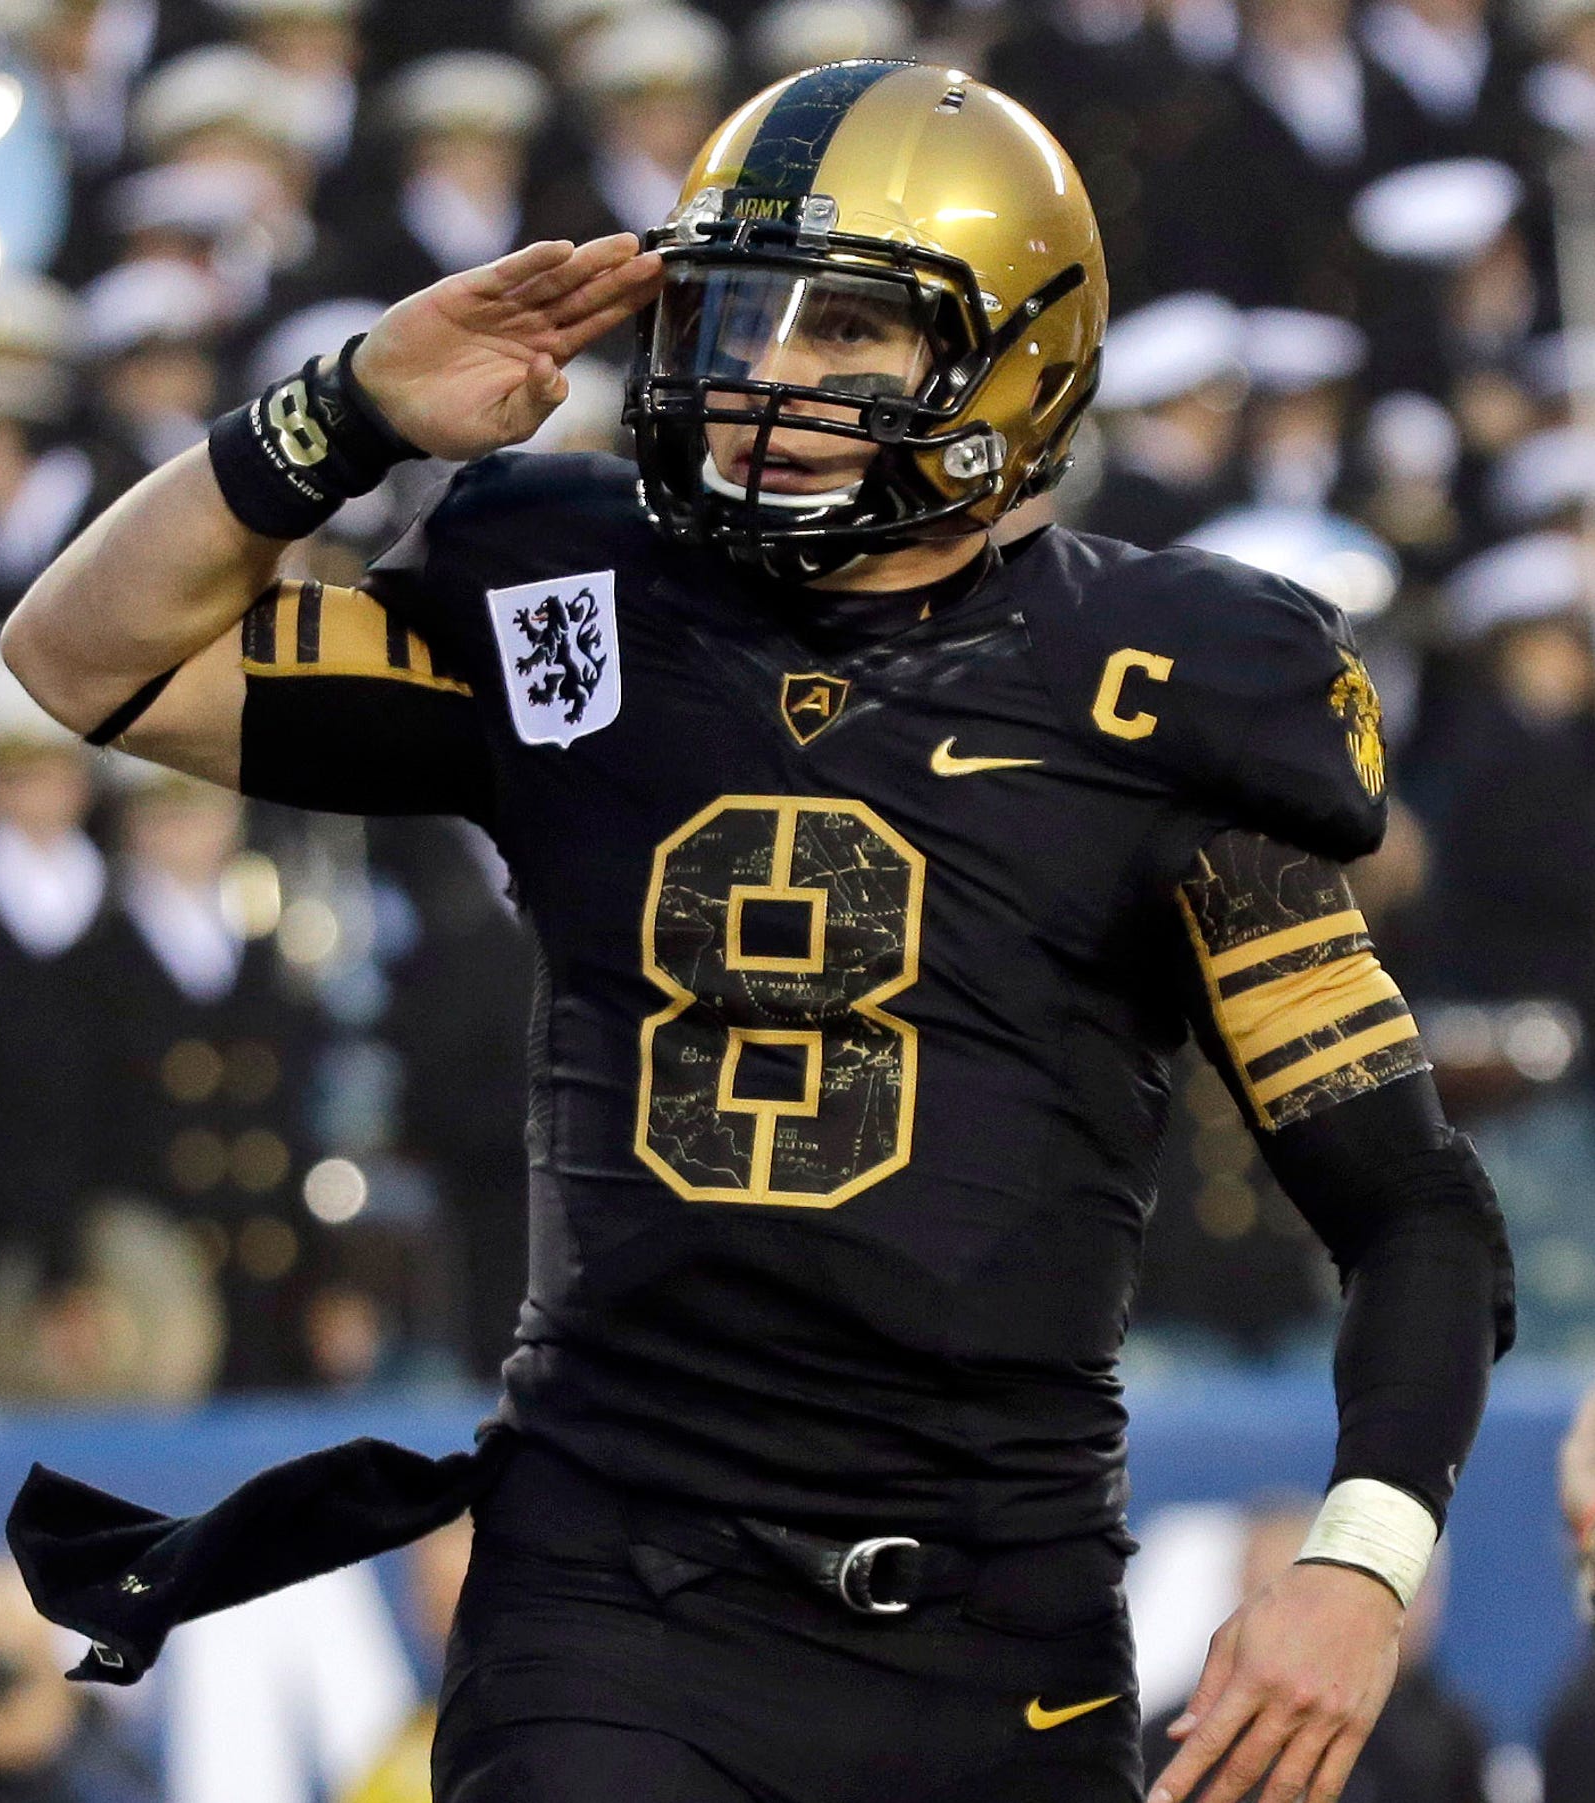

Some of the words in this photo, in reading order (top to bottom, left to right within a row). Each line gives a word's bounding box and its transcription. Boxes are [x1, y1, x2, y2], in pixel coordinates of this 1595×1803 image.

[734, 197, 790, 220] ARMY
[268, 379, 328, 467] 8
[790, 686, 830, 717] A
[1091, 646, 1175, 741] C
[634, 793, 927, 1209] 8
